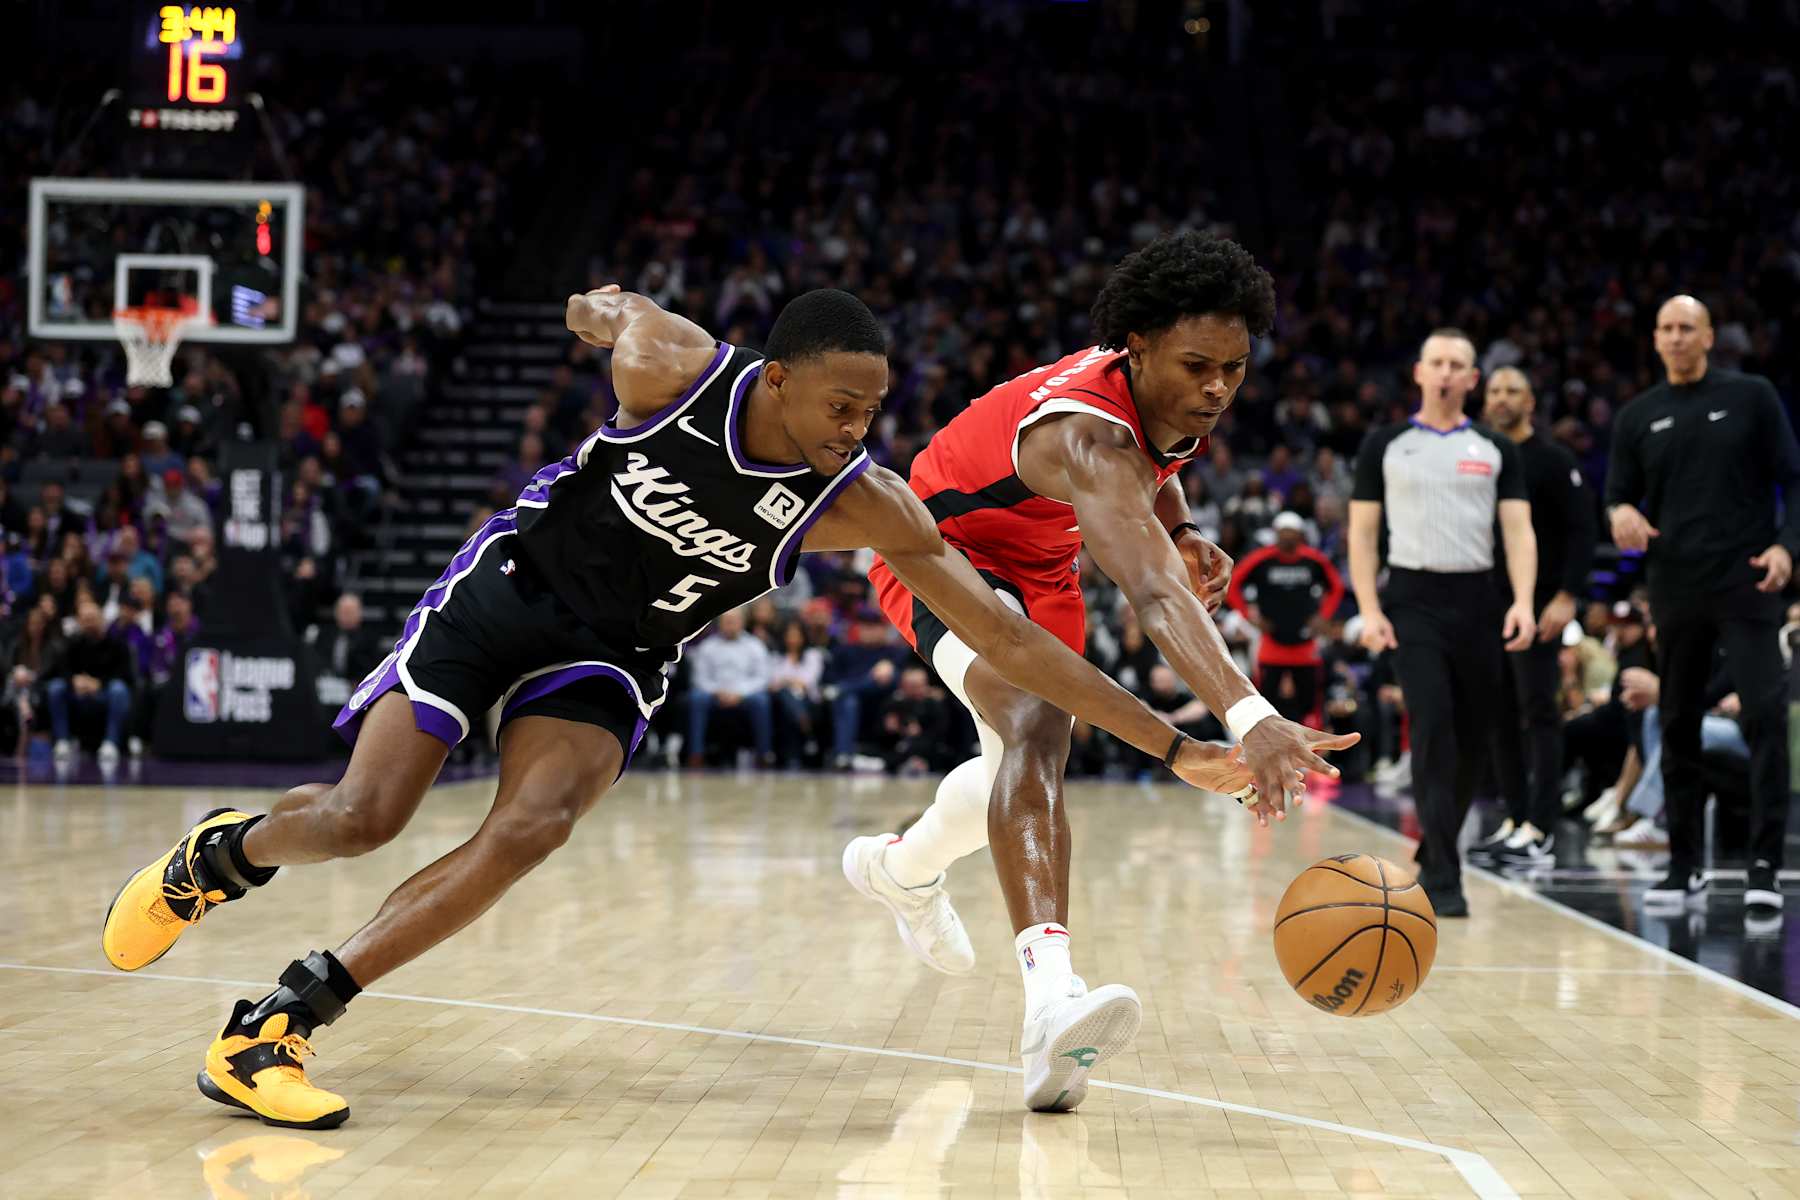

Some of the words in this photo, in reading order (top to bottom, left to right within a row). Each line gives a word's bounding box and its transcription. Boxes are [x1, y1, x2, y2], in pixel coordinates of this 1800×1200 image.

[159, 5, 236, 44] 3:44
[168, 42, 227, 103] 16
[160, 109, 238, 131] TISSOT
[611, 452, 757, 572] Kings
[769, 491, 795, 516] R
[652, 574, 720, 612] 5
[221, 650, 294, 688] League
[221, 687, 272, 722] Pass
